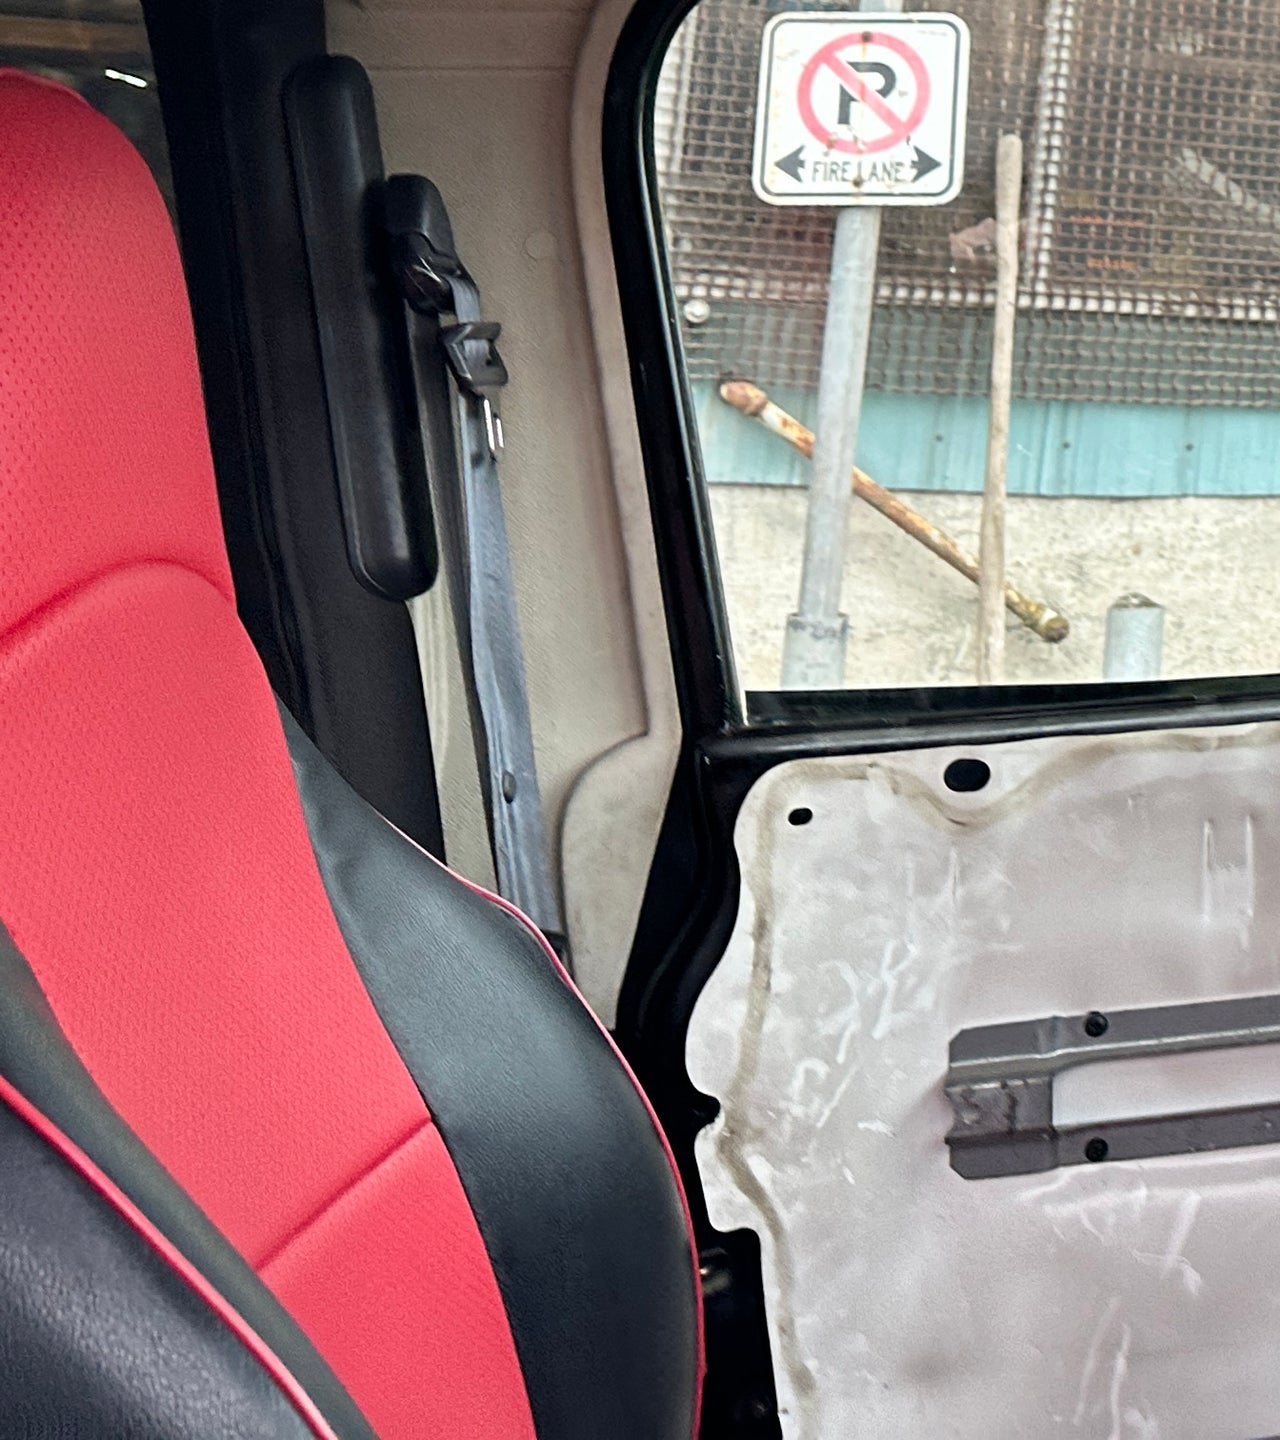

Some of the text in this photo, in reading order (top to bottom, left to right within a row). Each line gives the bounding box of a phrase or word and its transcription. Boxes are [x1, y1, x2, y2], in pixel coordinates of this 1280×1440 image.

[837, 61, 897, 126] P
[811, 160, 909, 182] FIRE LANE
